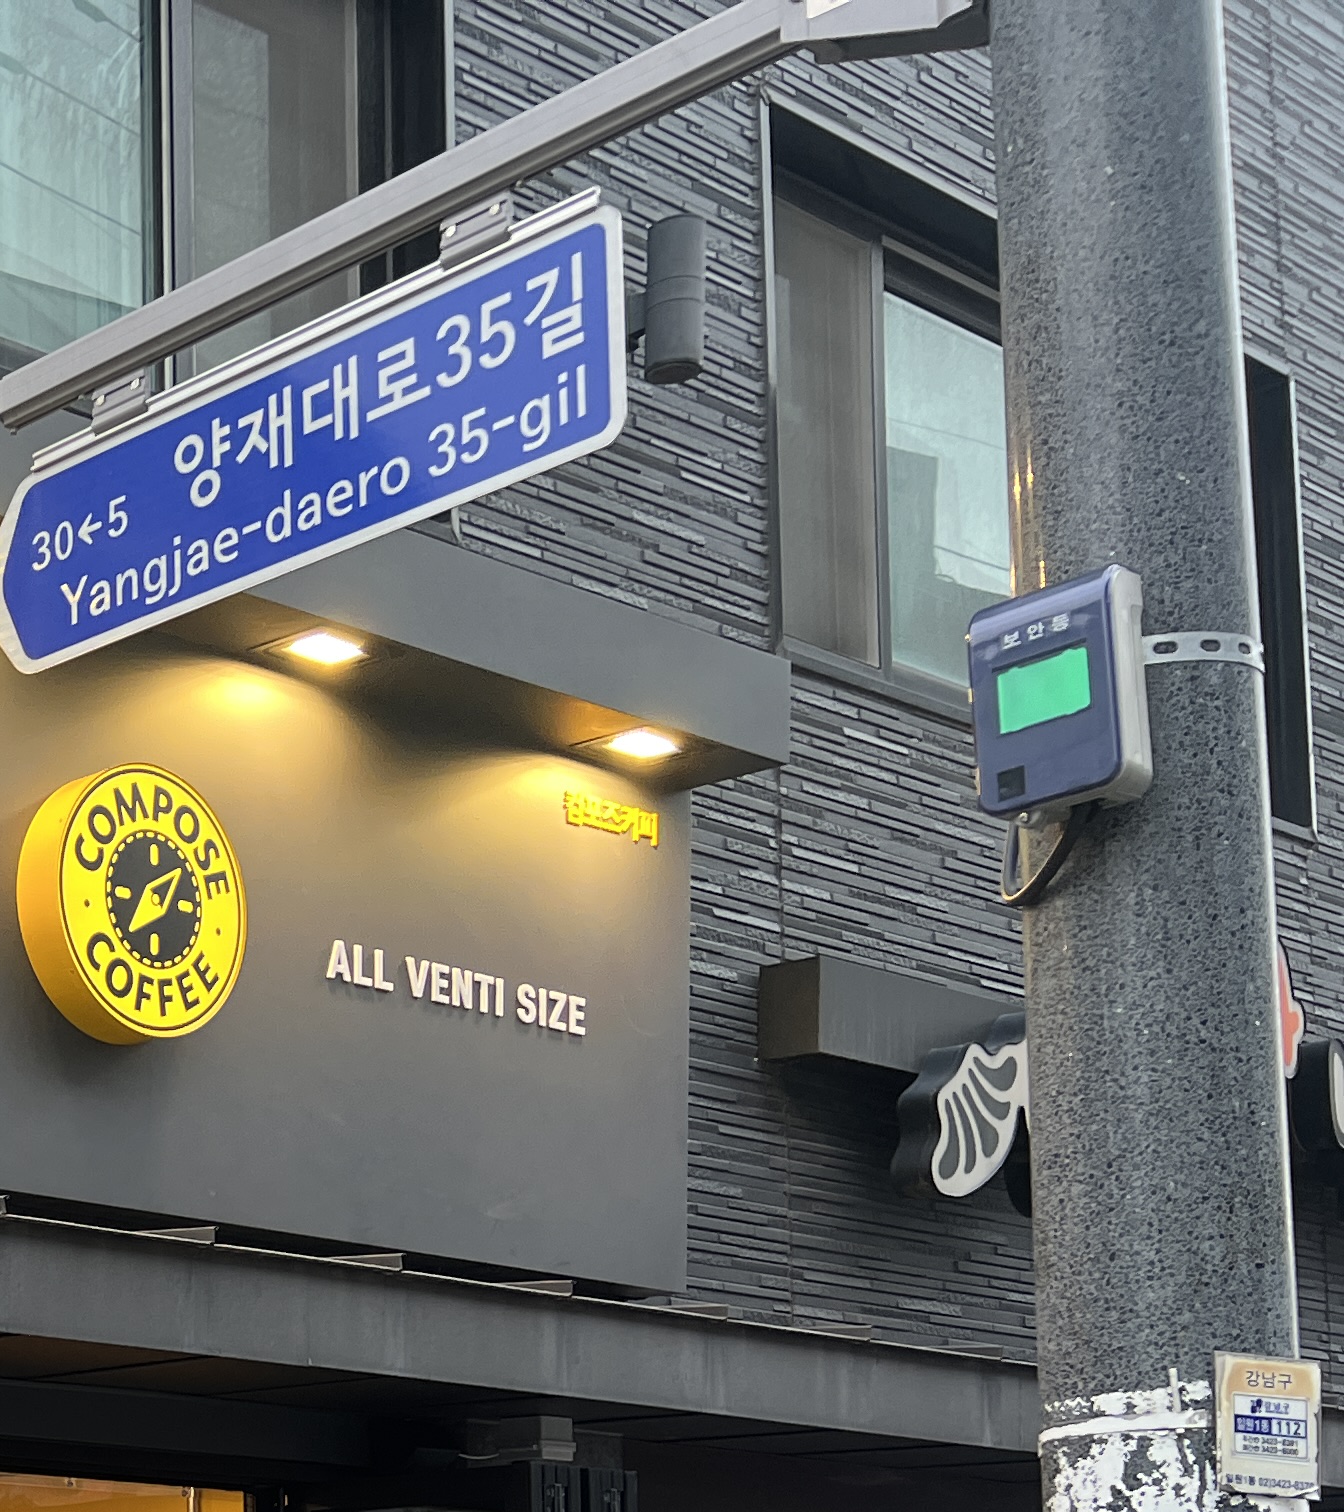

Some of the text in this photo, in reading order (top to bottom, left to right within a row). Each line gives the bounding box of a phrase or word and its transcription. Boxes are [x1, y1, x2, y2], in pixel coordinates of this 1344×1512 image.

[174, 250, 587, 510] 양재대로35길
[60, 363, 589, 627] Yangjae-daero 35-gil
[1003, 613, 1071, 650] 보안등
[73, 785, 231, 902] COMPOSE
[86, 930, 221, 1019] COFFEE
[326, 937, 589, 1037] ALL VENTI SIZE
[1245, 1370, 1293, 1391] 강남구
[1276, 1420, 1301, 1436] 112
